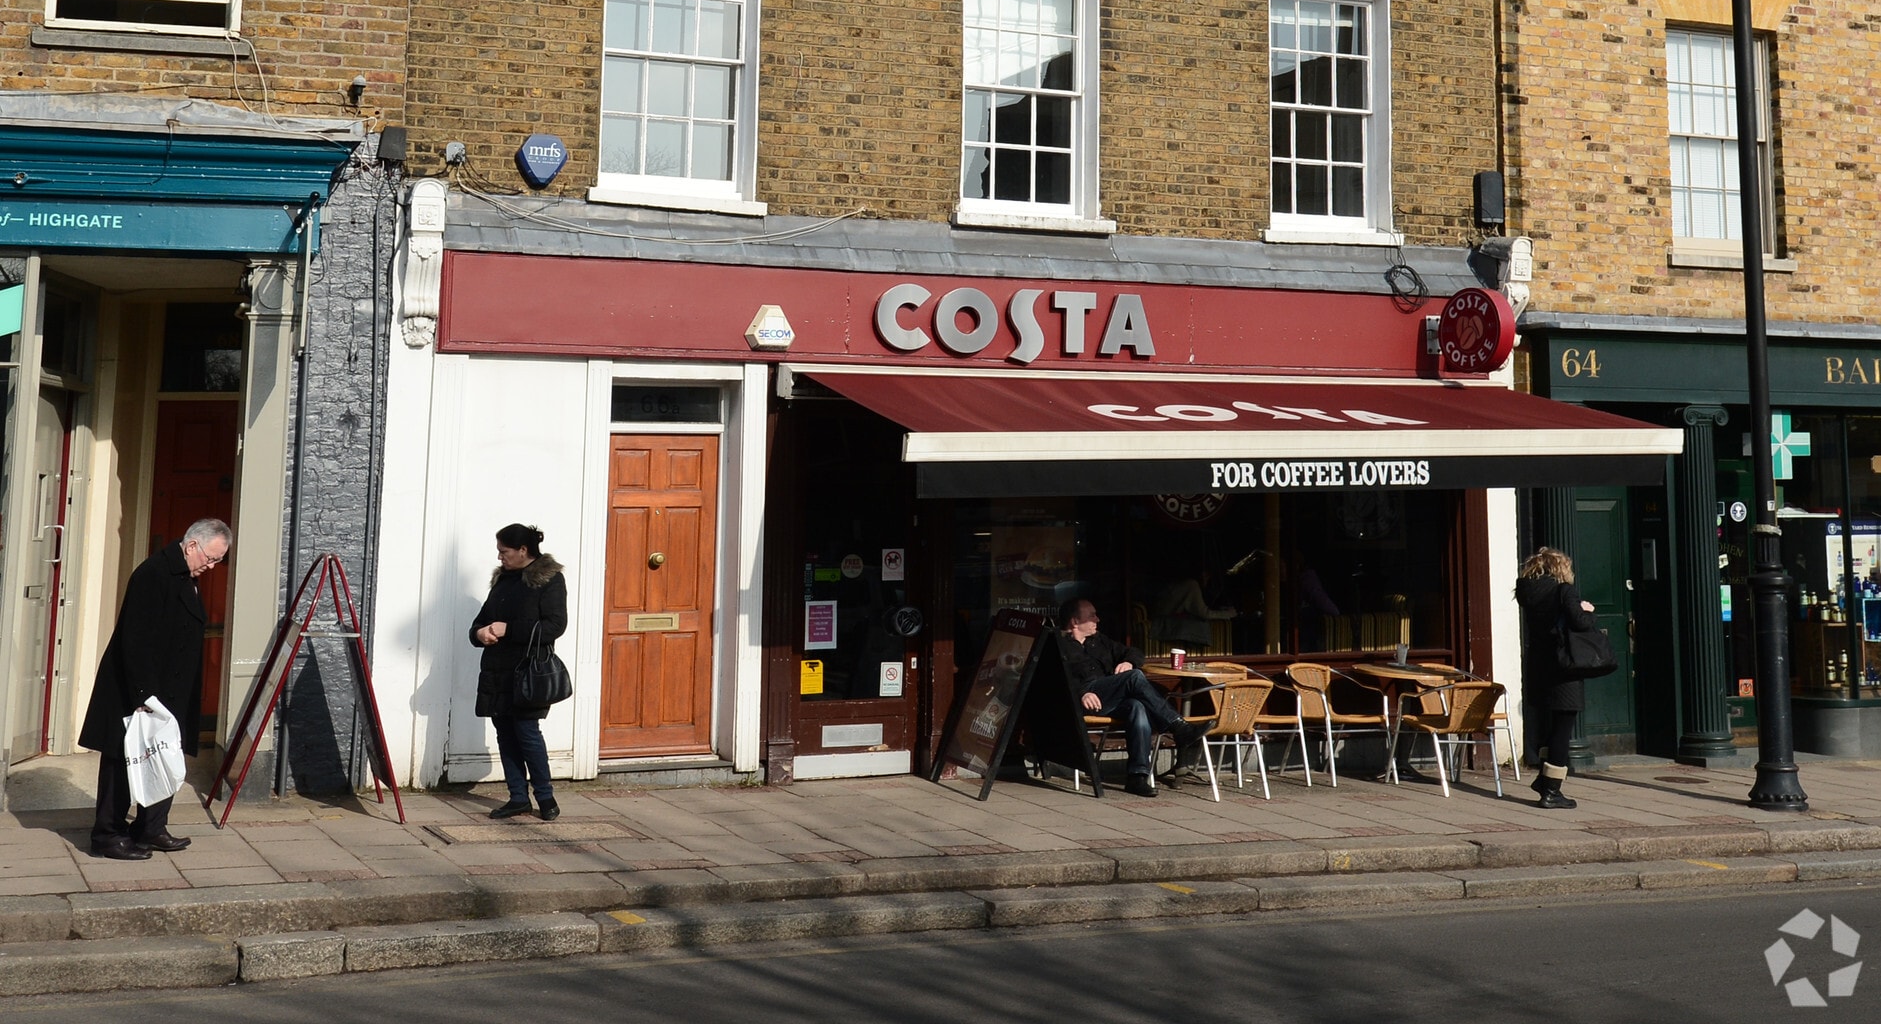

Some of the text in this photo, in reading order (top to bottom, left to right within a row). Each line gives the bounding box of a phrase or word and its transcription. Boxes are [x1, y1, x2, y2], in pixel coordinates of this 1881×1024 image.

[529, 143, 561, 157] mrfs
[29, 212, 123, 228] HIGHGATE
[1448, 295, 1488, 318] COSTA
[758, 329, 791, 338] SECOM
[876, 283, 1156, 363] COSTA
[1446, 339, 1493, 367] COFFEE
[1562, 348, 1602, 378] 64
[641, 394, 680, 414] 66a
[1087, 401, 1430, 425] COSTA
[1211, 460, 1430, 487] FOR COFFEE LOVERS
[1008, 618, 1027, 629] COSTA
